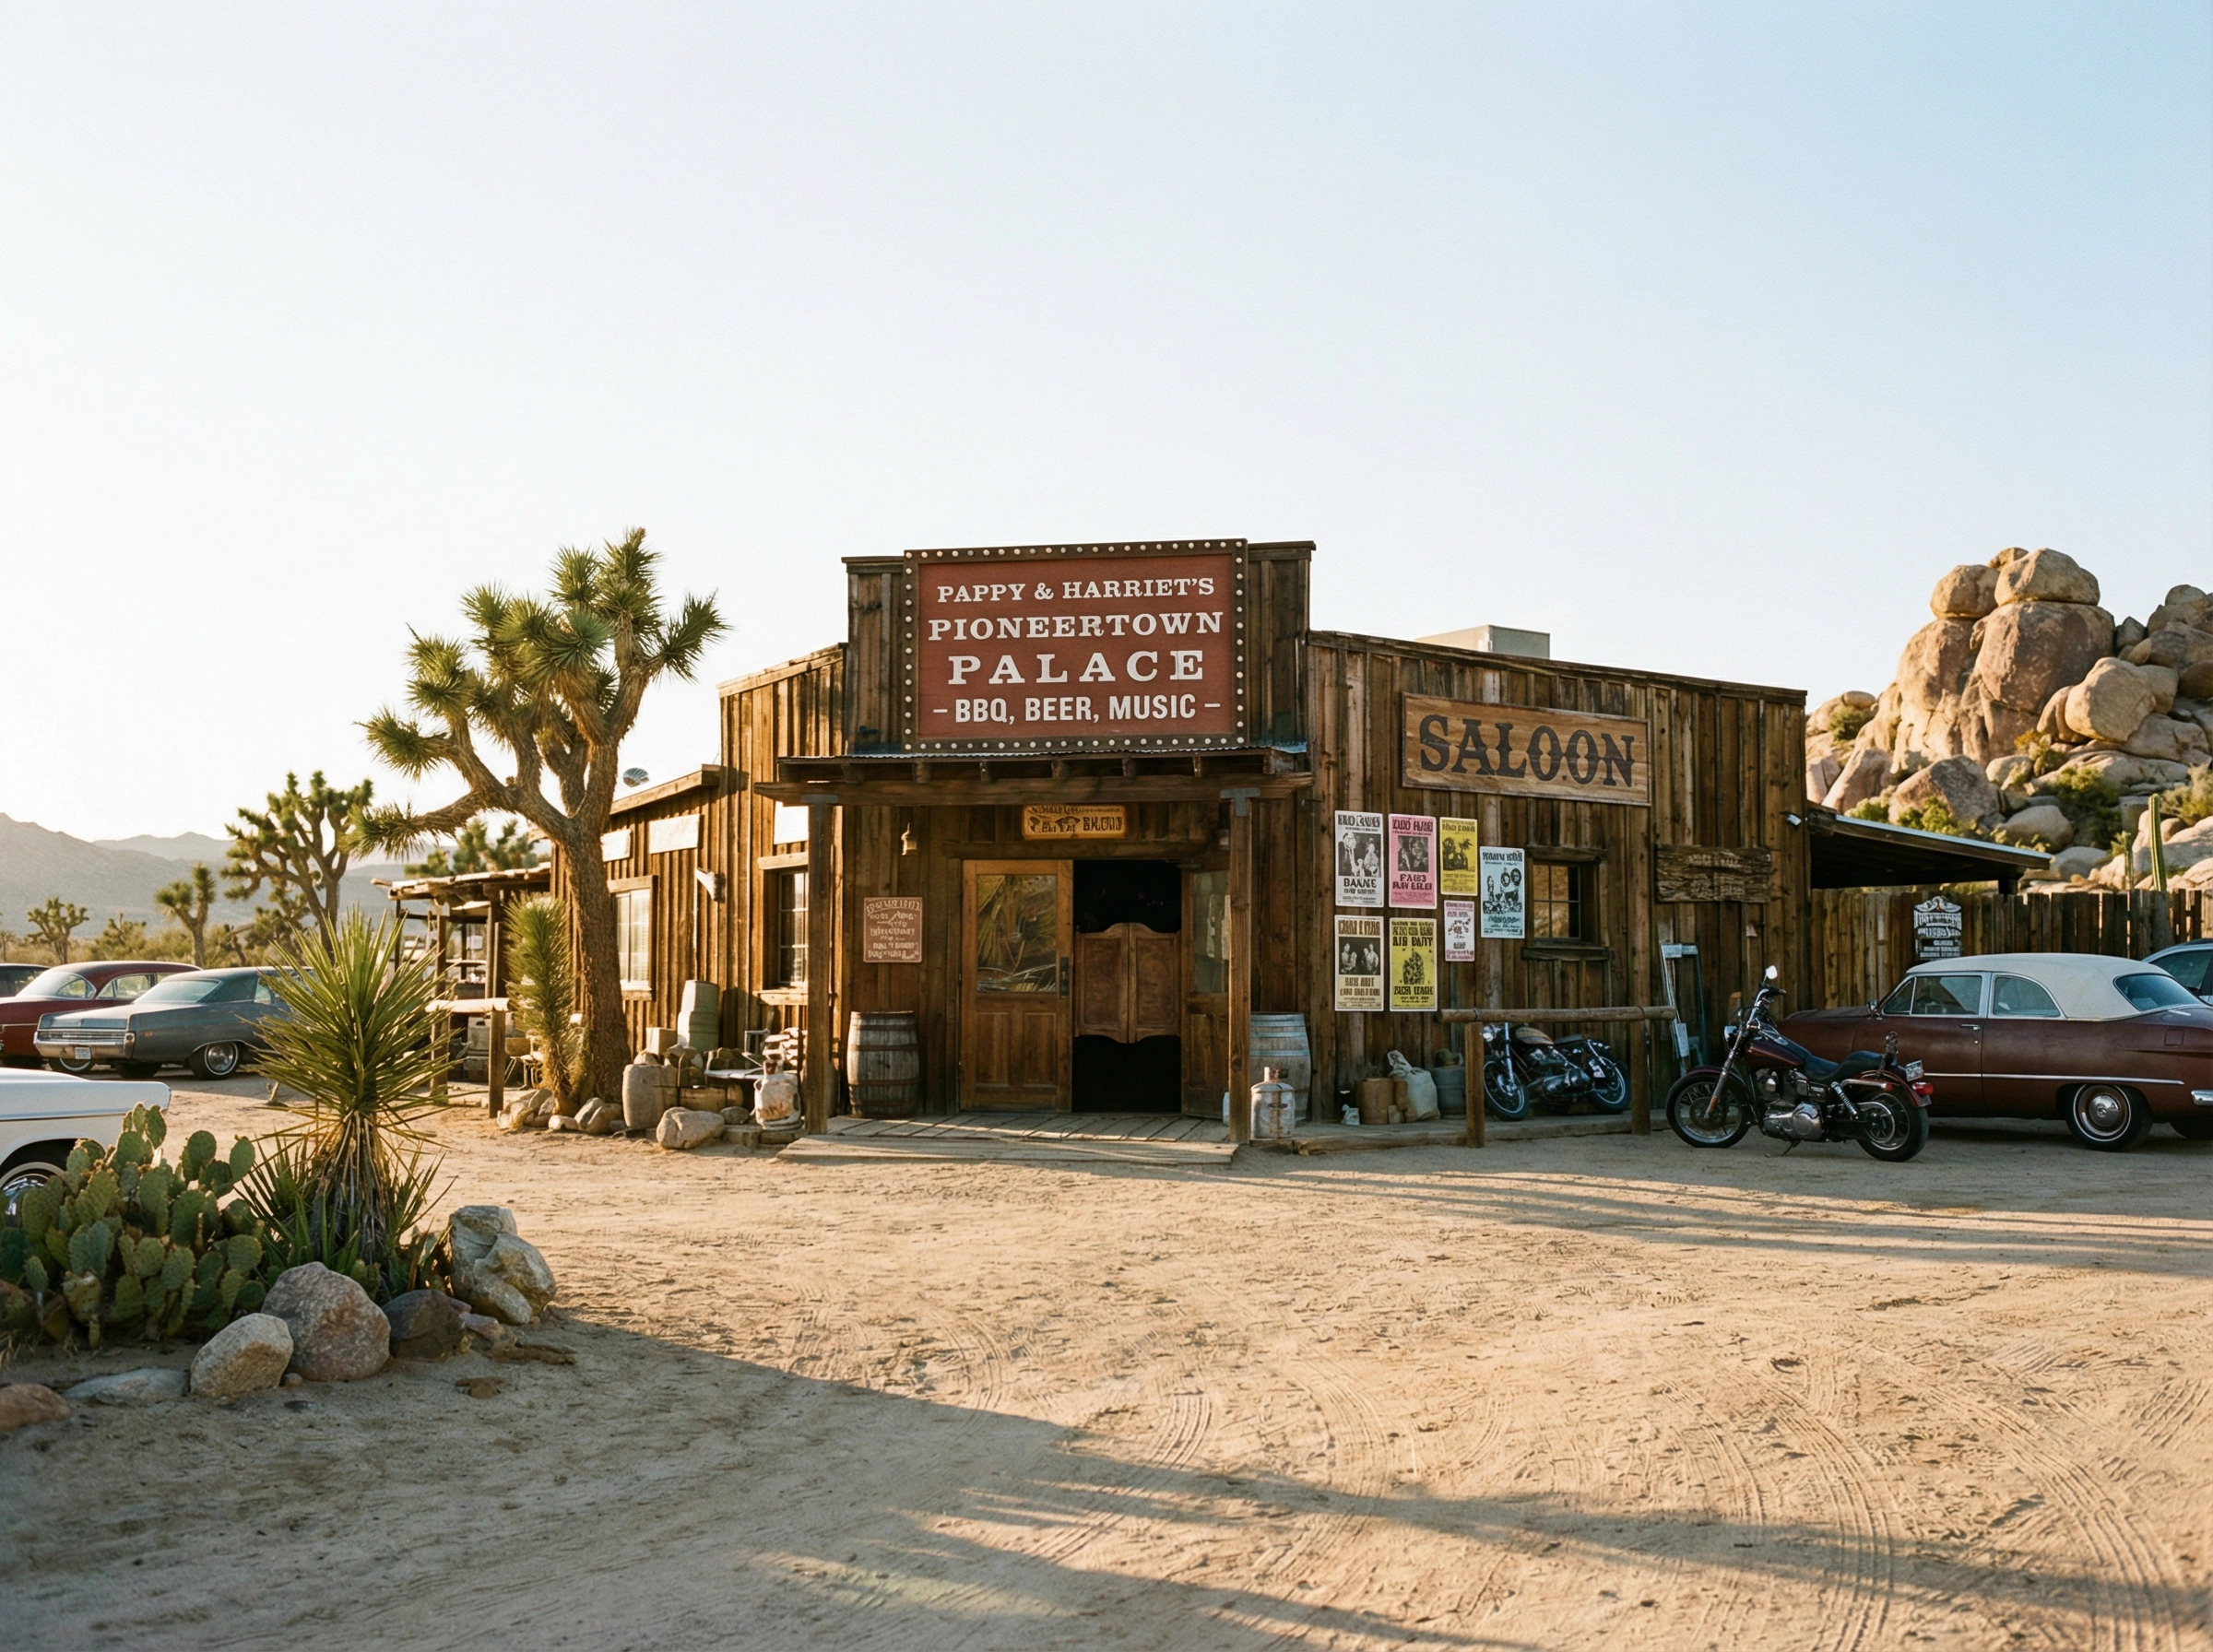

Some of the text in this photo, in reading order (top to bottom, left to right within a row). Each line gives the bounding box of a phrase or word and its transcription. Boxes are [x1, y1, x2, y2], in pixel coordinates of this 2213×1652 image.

[937, 577, 1214, 603] PAPPY & HARRIET'S
[928, 611, 1224, 641] PIONEERTOWN
[948, 650, 1203, 685] PALACE
[955, 693, 1196, 726] BBQ, BEER, MUSIC
[1419, 714, 1635, 787] SALOON
